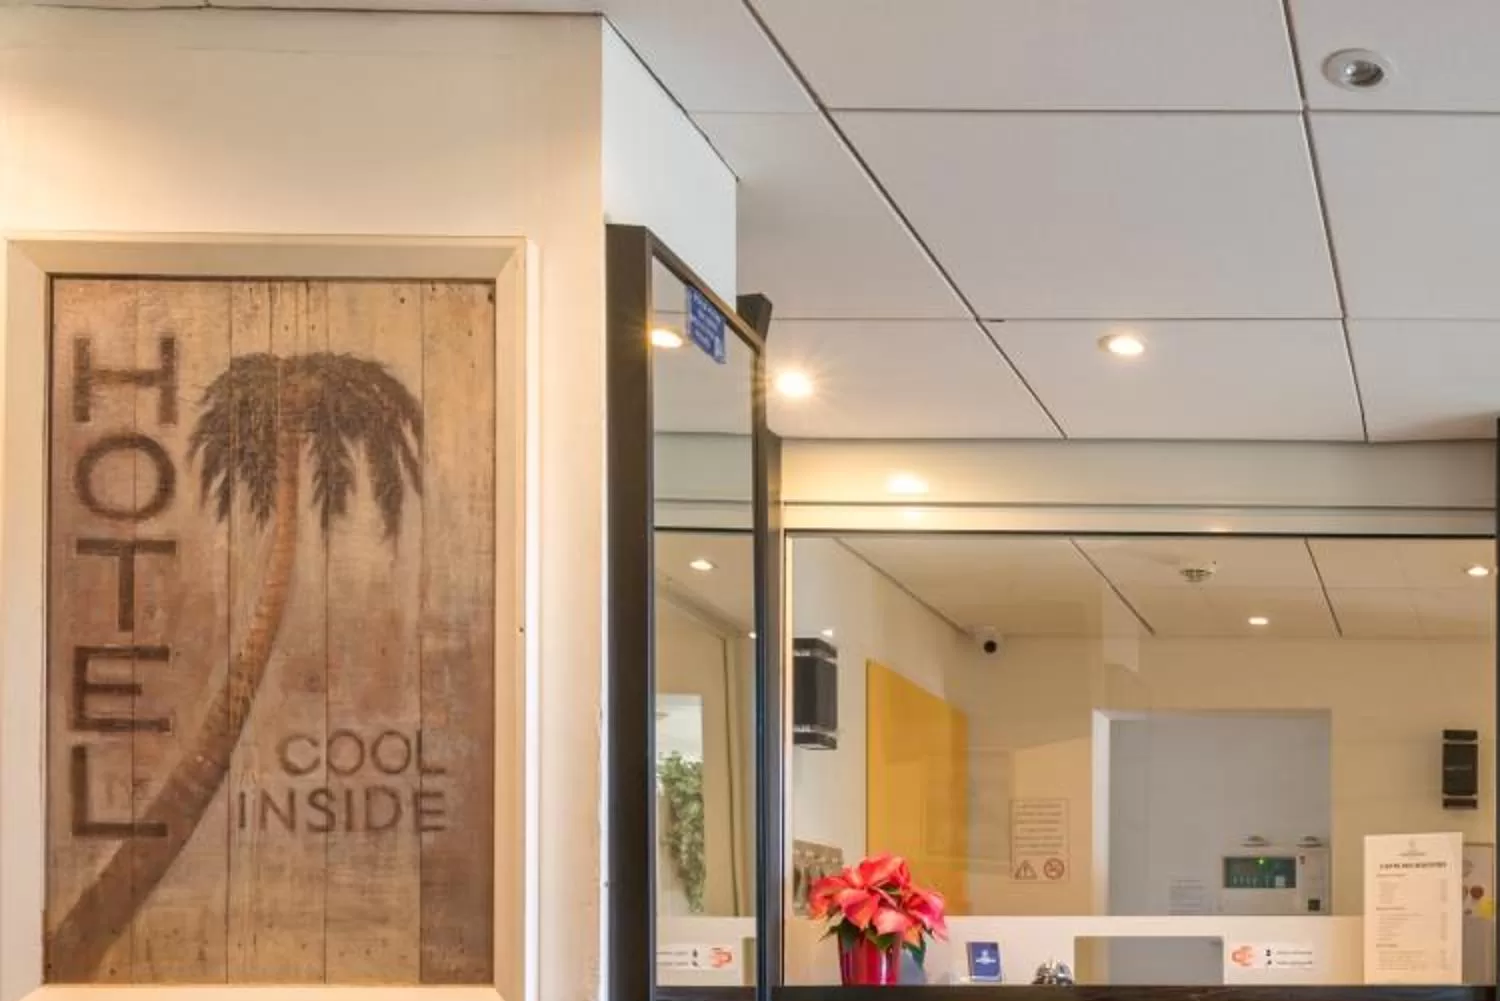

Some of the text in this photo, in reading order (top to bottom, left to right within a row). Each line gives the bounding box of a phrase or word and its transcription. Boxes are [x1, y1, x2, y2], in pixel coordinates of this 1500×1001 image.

[71, 332, 178, 839] HOTEL
[277, 728, 446, 776] COOL
[239, 783, 447, 833] INSIDE
